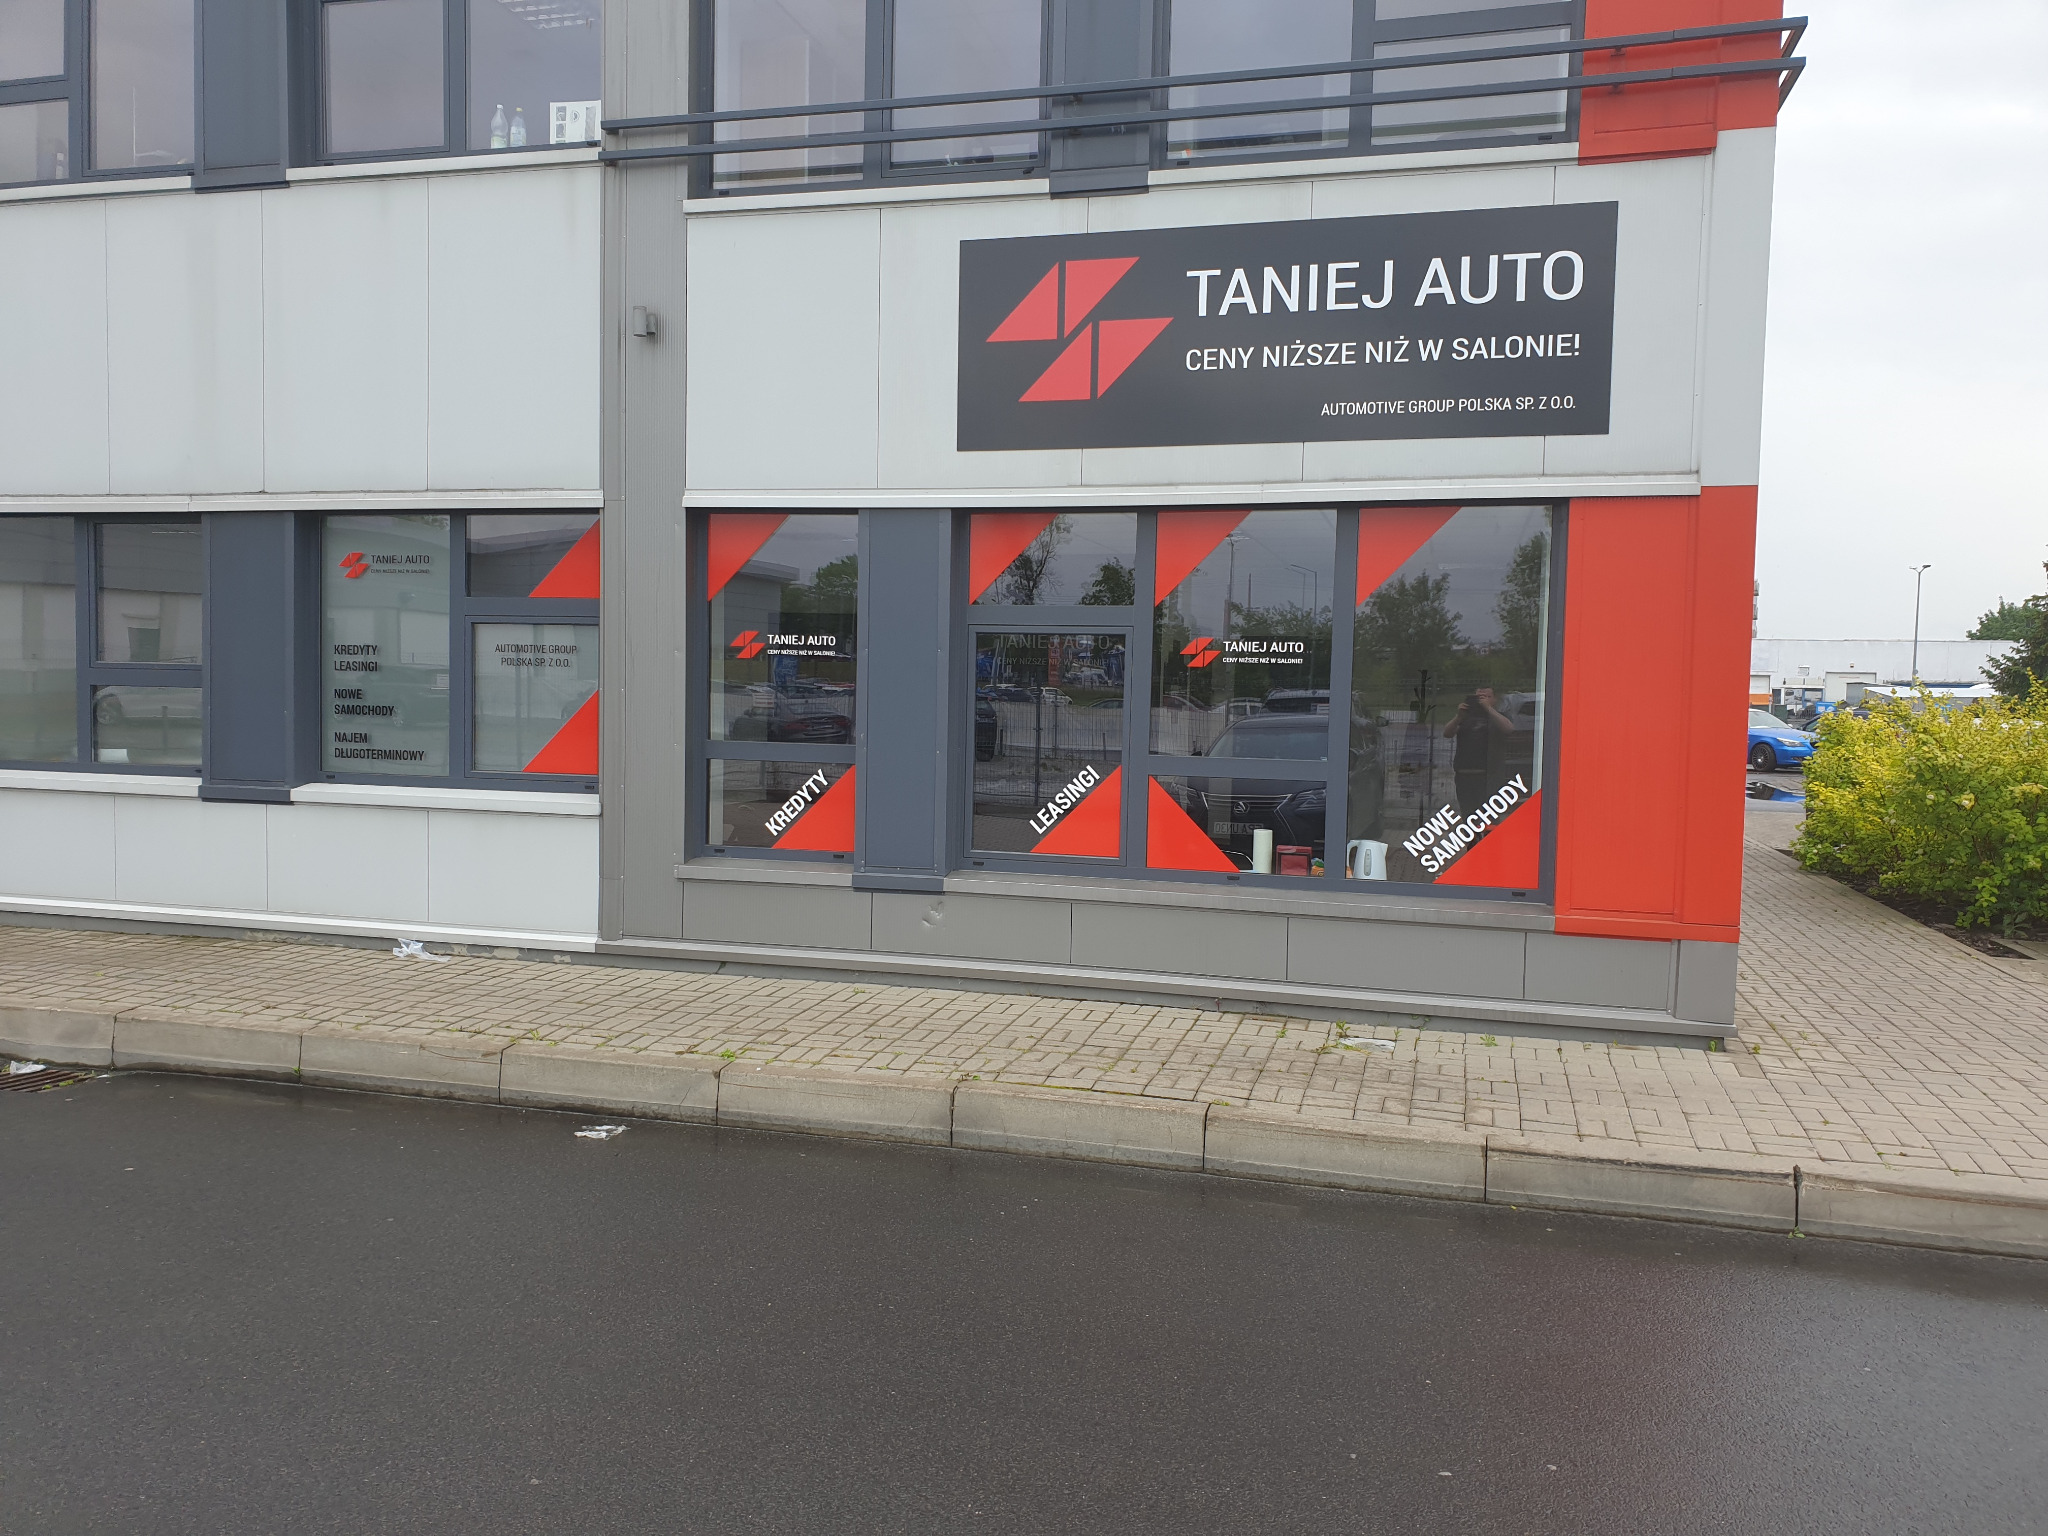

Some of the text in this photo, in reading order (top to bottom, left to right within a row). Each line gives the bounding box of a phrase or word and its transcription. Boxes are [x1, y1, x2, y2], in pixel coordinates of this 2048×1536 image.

[1186, 250, 1584, 317] TANIEJ AUTO
[1185, 333, 1580, 371] CENY NIŻSZE NIŻ W SALONIE!
[1321, 395, 1576, 416] AUTOMOTIVE GROUP POLSKA SP. Z O.O.
[371, 554, 430, 565] TANIEJ AUTO
[767, 634, 836, 646] TANIEJ AUTO
[334, 644, 378, 656] KREDYTY
[495, 644, 577, 655] AUTOMOTIVE GROUP
[1223, 641, 1304, 653] TANIEJ AUTO
[334, 660, 378, 672] LEASINGI
[501, 657, 533, 667] POLSKA
[534, 657, 546, 667] SP.
[334, 688, 363, 700] NOWE
[334, 704, 395, 717] SAMOCHODY
[334, 731, 368, 744] NAJEM
[334, 747, 425, 761] DŁUGOTERMINOWY
[764, 768, 829, 837] KREDYTY
[1029, 764, 1101, 835] LEASINGI
[1420, 773, 1528, 873] SAMOCHODY
[1402, 803, 1462, 858] NOWE
